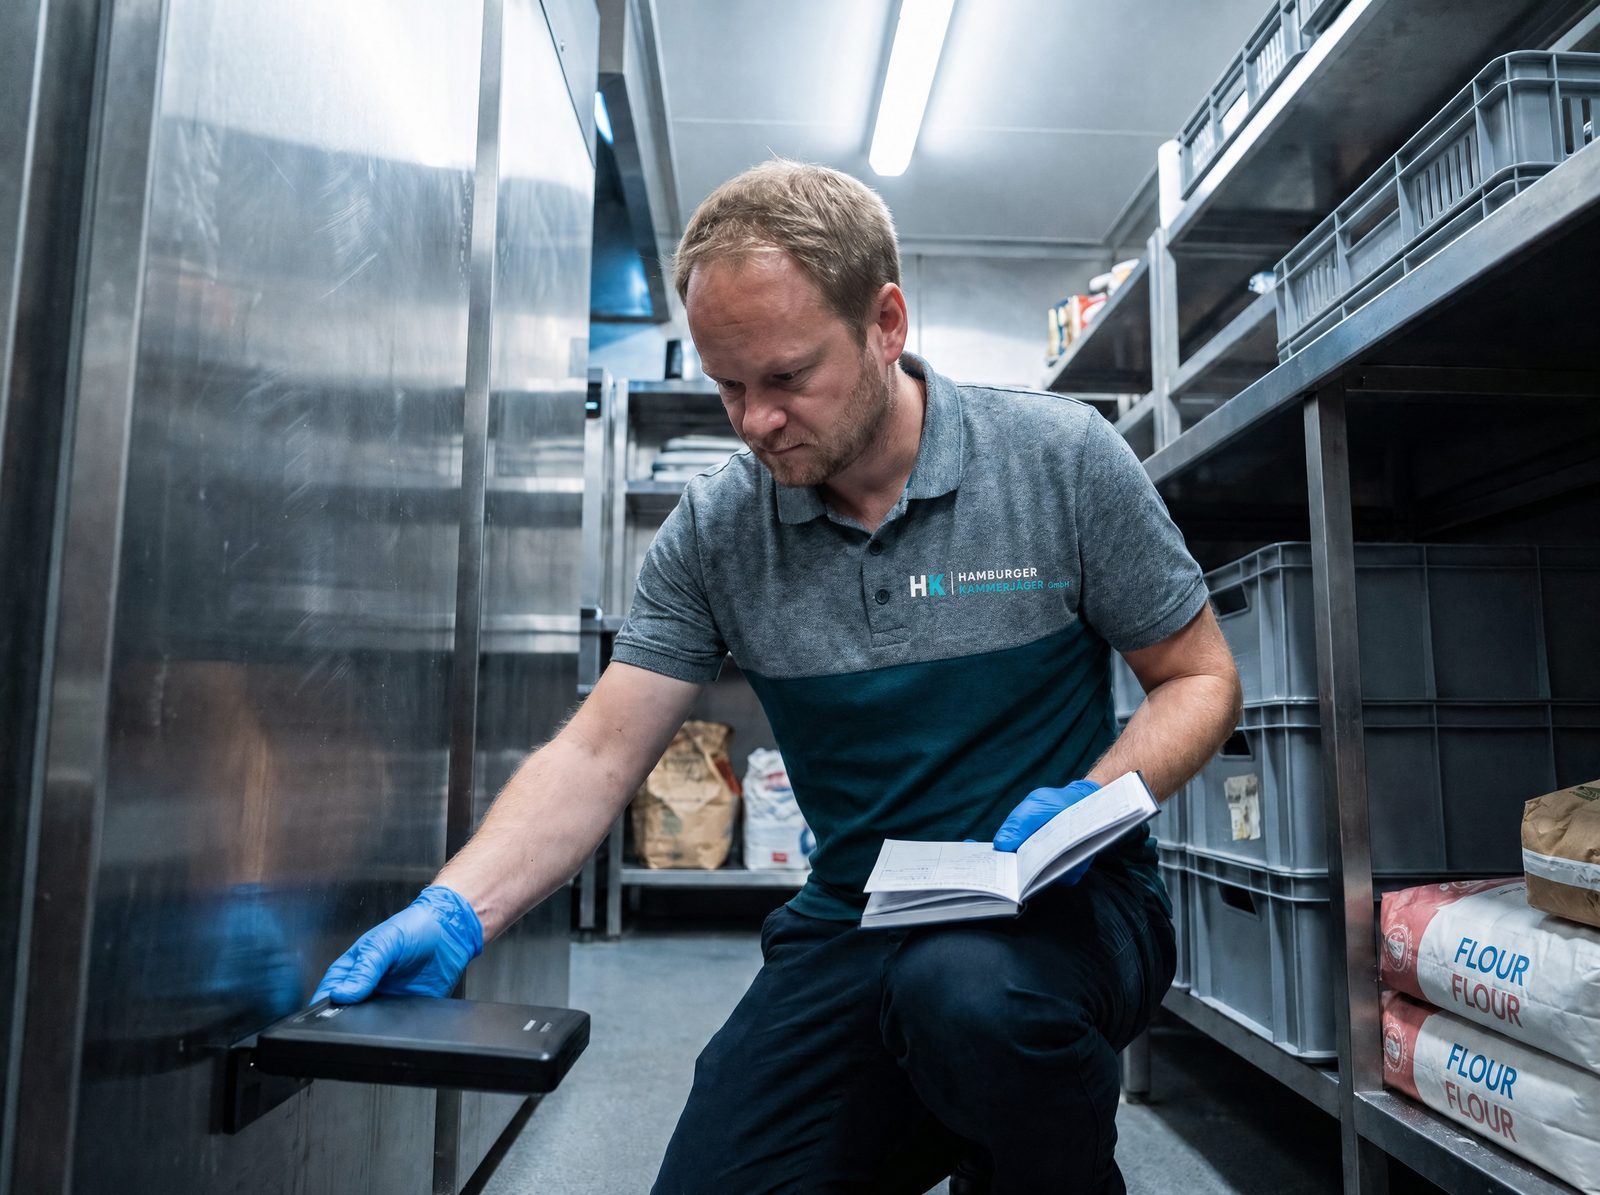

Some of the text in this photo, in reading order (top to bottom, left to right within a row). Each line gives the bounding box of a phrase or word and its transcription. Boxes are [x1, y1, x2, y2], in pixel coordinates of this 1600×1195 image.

[909, 574, 947, 598] HK
[958, 567, 1038, 582] HAMBURGER
[1453, 937, 1530, 987] FLOUR
[1451, 973, 1524, 1029] FLOUR
[1446, 1043, 1517, 1100] FLOUR
[1445, 1079, 1518, 1144] FLOUR
